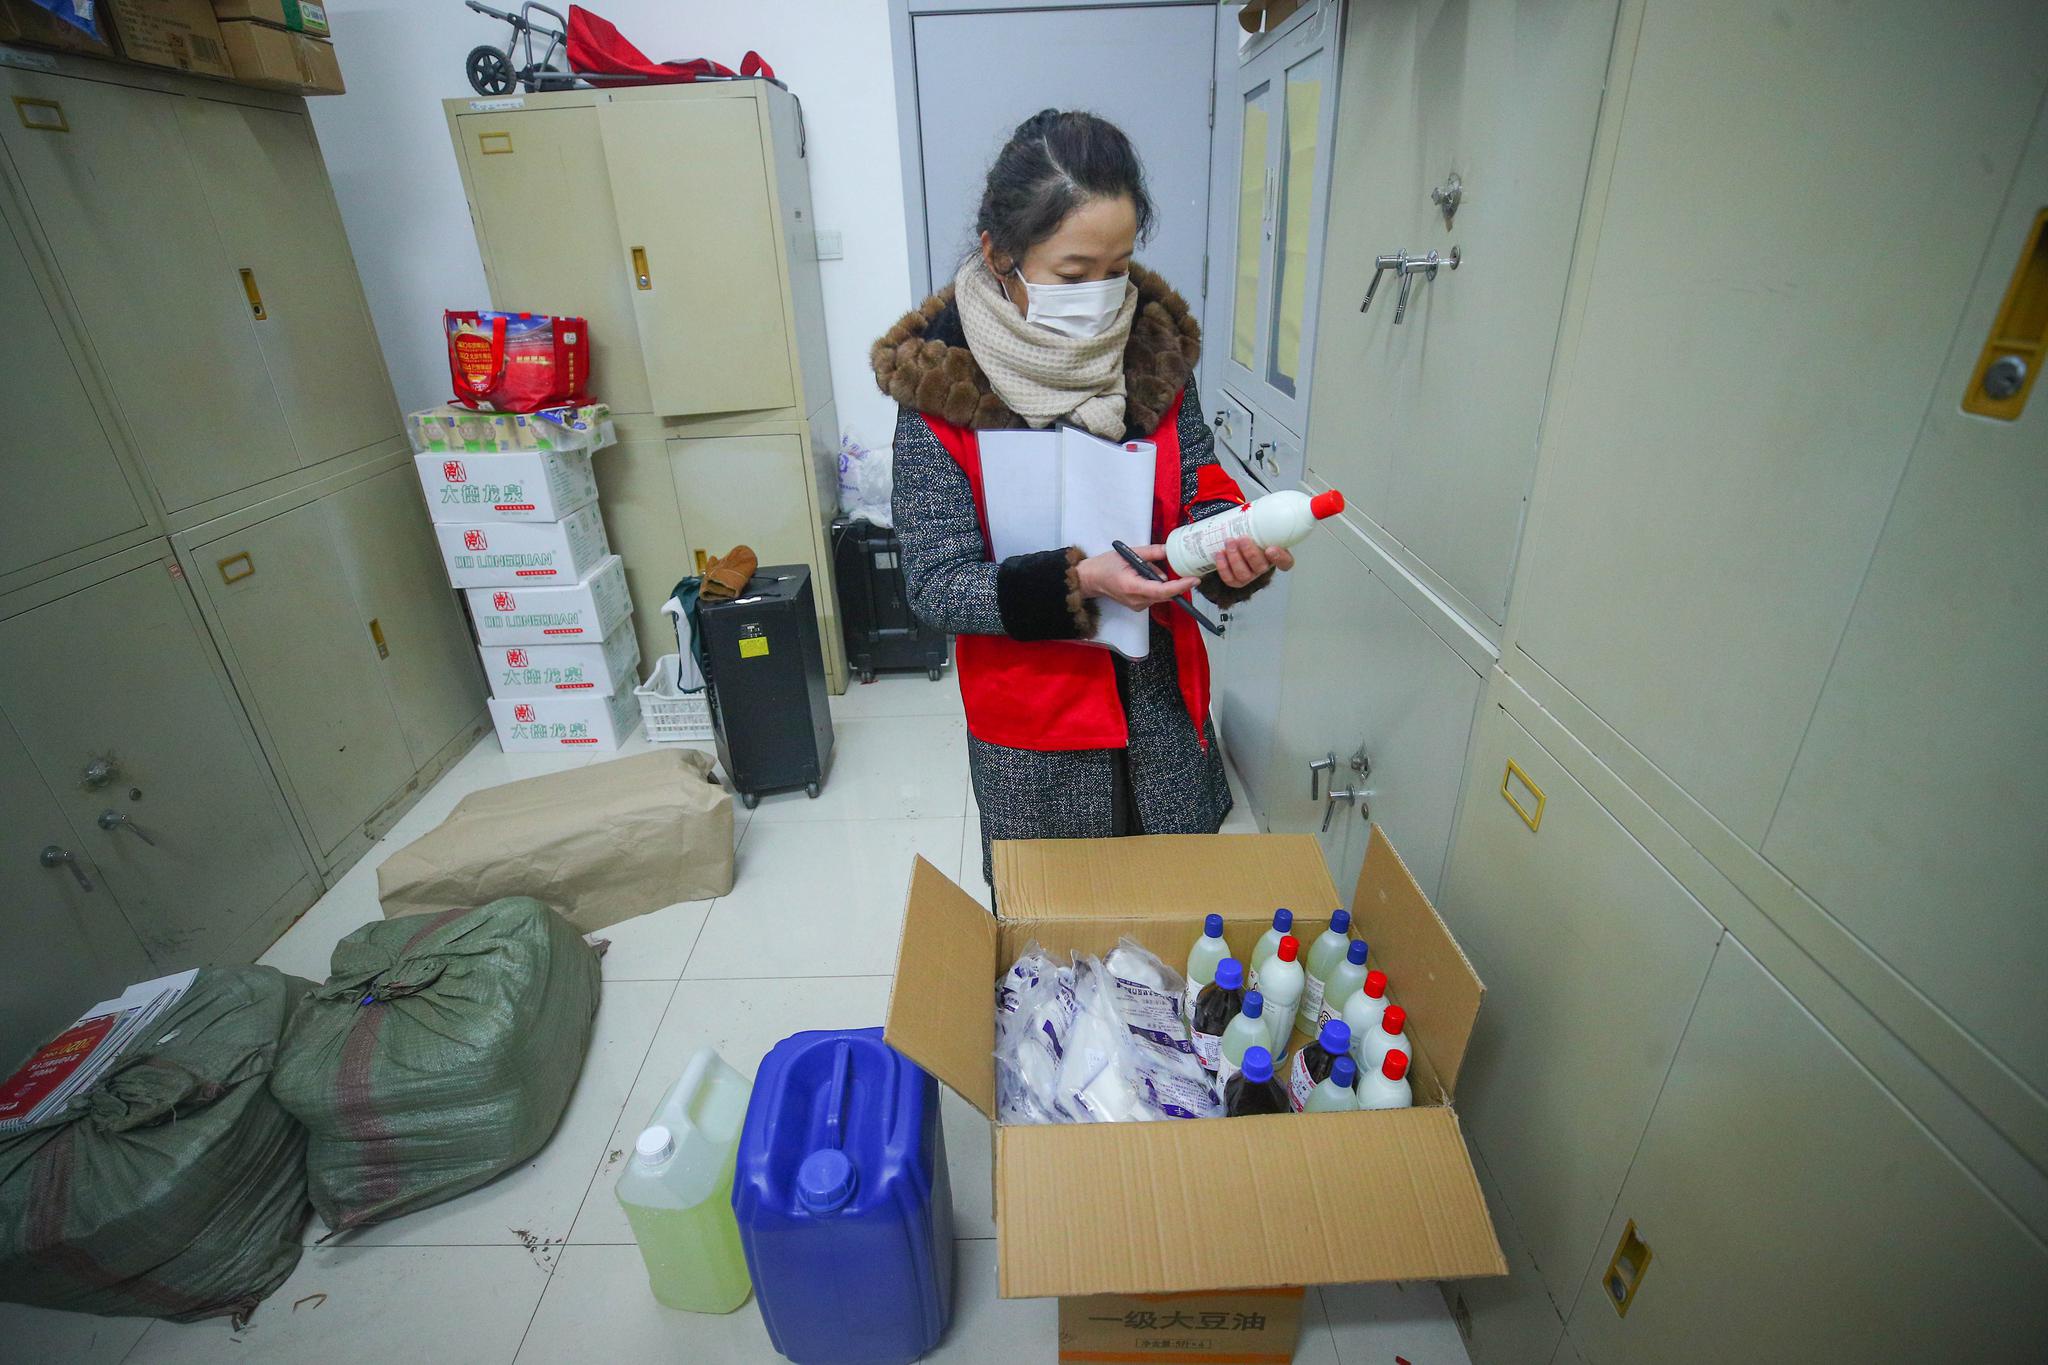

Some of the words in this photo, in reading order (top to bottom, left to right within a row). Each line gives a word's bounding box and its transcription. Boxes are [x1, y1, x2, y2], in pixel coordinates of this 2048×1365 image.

[440, 484, 524, 504] 大德龙泉
[477, 553, 553, 568] LONGQUAN
[506, 612, 579, 627] LONGQUAN
[503, 667, 584, 686] 大德龙泉
[511, 720, 589, 739] 大德龙泉
[1089, 1311, 1266, 1332] 一级大豆油
